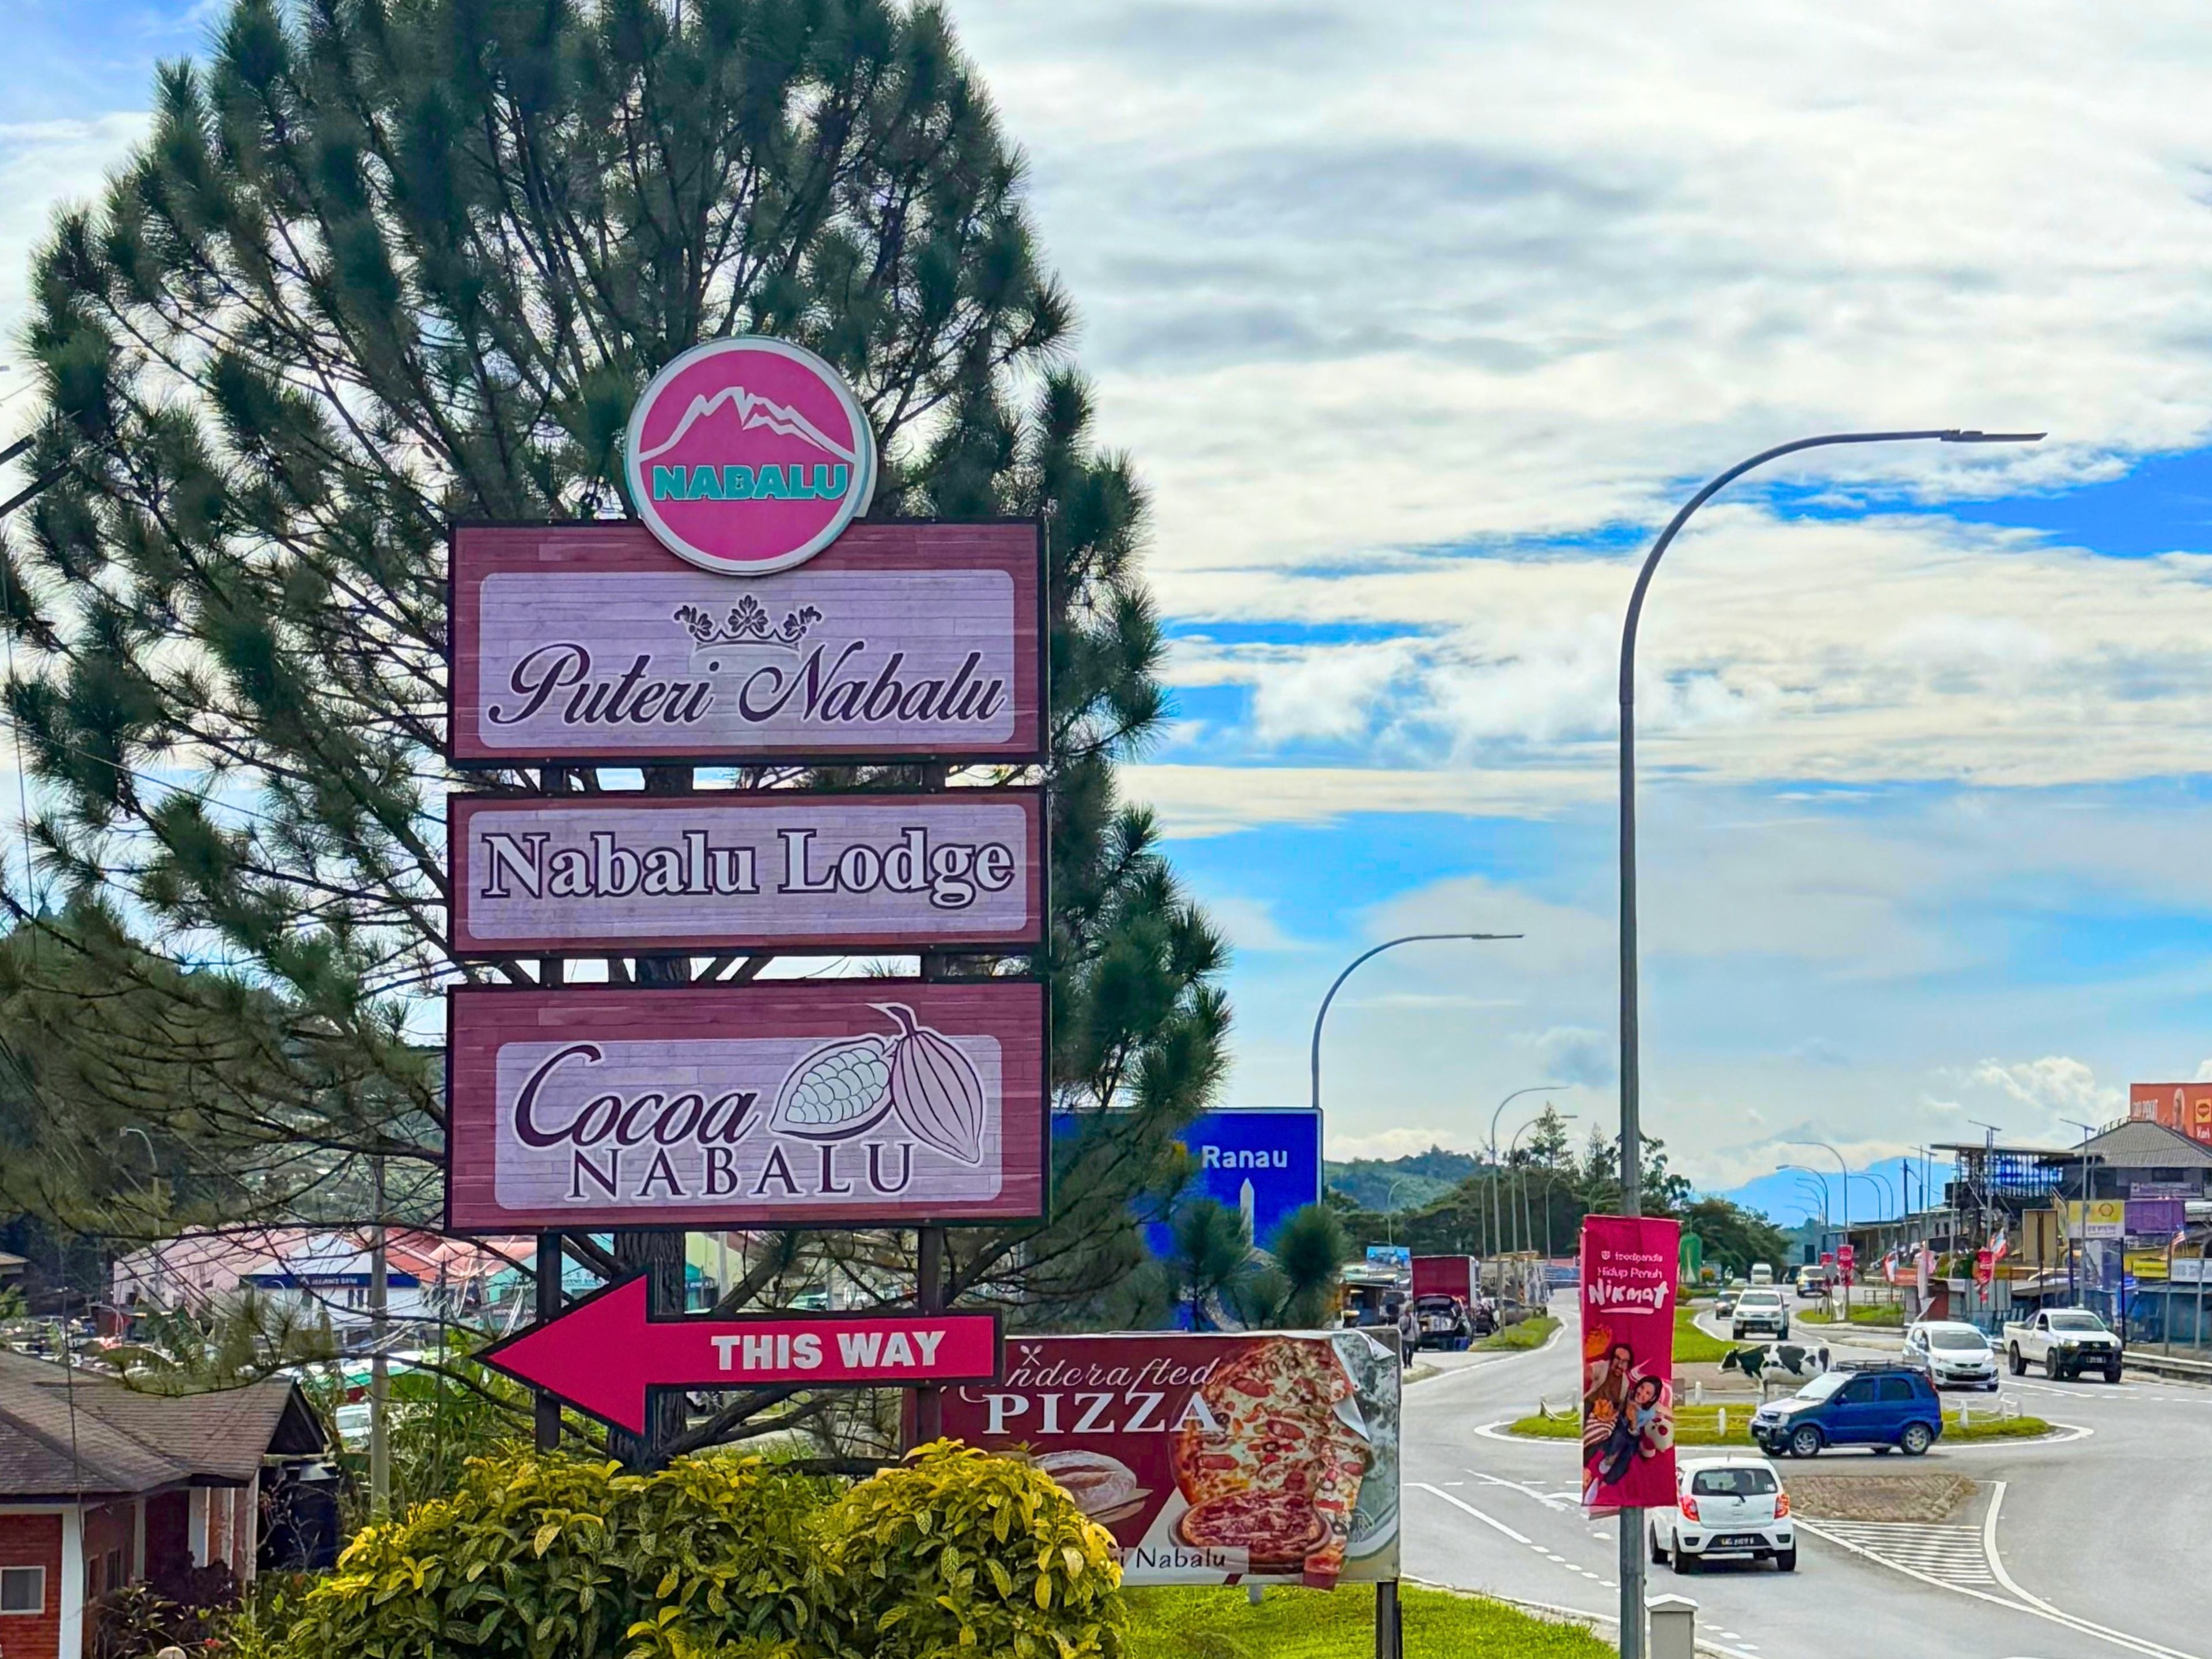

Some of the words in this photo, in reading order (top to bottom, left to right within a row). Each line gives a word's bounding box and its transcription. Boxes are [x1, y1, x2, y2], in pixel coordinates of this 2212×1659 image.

[653, 464, 848, 501] NABALU
[487, 642, 719, 725] Puteri
[737, 639, 1007, 722] Nabalu
[481, 830, 760, 899] Nabalu
[777, 827, 1014, 910] Lodge
[514, 1044, 759, 1147] Cocoa
[567, 1142, 913, 1199] NABALU
[1202, 1145, 1288, 1168] Ranau
[711, 1334, 823, 1370] THIS
[836, 1331, 946, 1368] WAY
[959, 1357, 1221, 1403] ndcrafted
[982, 1391, 1226, 1434] PIZZA
[1136, 1547, 1226, 1569] Nabalu
